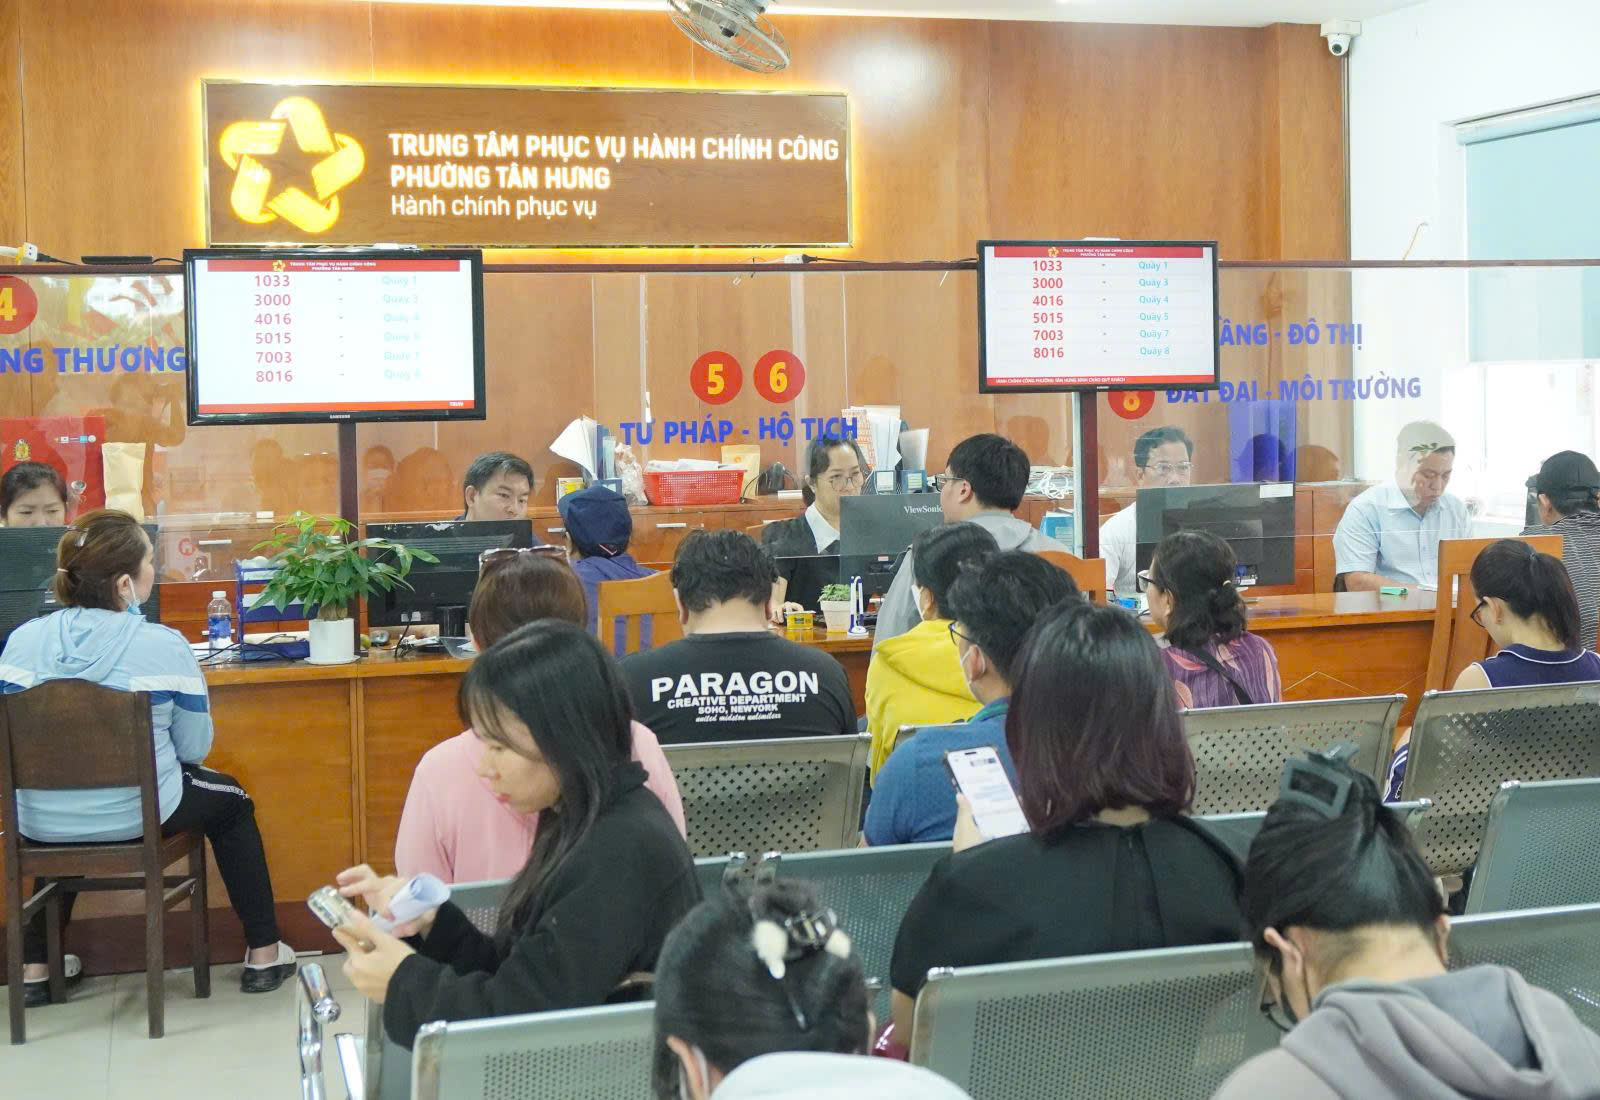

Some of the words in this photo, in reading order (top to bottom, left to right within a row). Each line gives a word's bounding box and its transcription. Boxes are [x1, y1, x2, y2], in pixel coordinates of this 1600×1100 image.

[388, 133, 468, 157] TRUNG
[474, 130, 519, 157] TÂM
[526, 135, 590, 162] PHỤC
[595, 136, 626, 163] VỤ
[633, 132, 696, 160] HÀNH
[702, 134, 772, 160] CHÍNH
[778, 134, 839, 160] CÔNG
[391, 161, 491, 188] PHƯỜNG
[496, 162, 538, 188] TÂN
[545, 166, 610, 189] HƯNG
[391, 194, 446, 216] Hành
[452, 195, 510, 216] chính
[516, 195, 568, 220] phục
[573, 200, 597, 220] vụ
[1033, 261, 1062, 271] 1033
[255, 275, 290, 287] 1033
[1033, 278, 1063, 288] 3000
[255, 294, 291, 306] 3000
[1033, 296, 1063, 306] 4016
[255, 313, 291, 325] 4016
[1033, 313, 1063, 324] 5015
[255, 333, 291, 344] 5015
[1033, 330, 1064, 341] 7003
[1216, 316, 1268, 346] ẦNG
[1288, 318, 1320, 344] ĐÔ
[1325, 323, 1363, 350] THỊ
[0, 347, 44, 373] NG
[53, 344, 186, 373] THƯƠNG
[256, 352, 292, 363] 7003
[1033, 348, 1064, 358] 8016
[256, 371, 293, 382] 8016
[707, 363, 725, 395] 5
[769, 362, 788, 393] 6
[1219, 380, 1257, 402] ĐAI
[1280, 374, 1322, 401] MÔI
[1329, 371, 1421, 401] TRƯỜNG
[620, 418, 656, 445] TƯ
[664, 412, 733, 444] PHÁP
[759, 411, 794, 446] HỘ
[801, 416, 858, 446] TỊCH
[652, 670, 819, 702] PARAGON
[667, 696, 727, 709] CREATIVE
[730, 694, 807, 705] DEPARTMENT
[698, 705, 728, 715] SOHO,
[731, 704, 778, 714] NEWYORK
